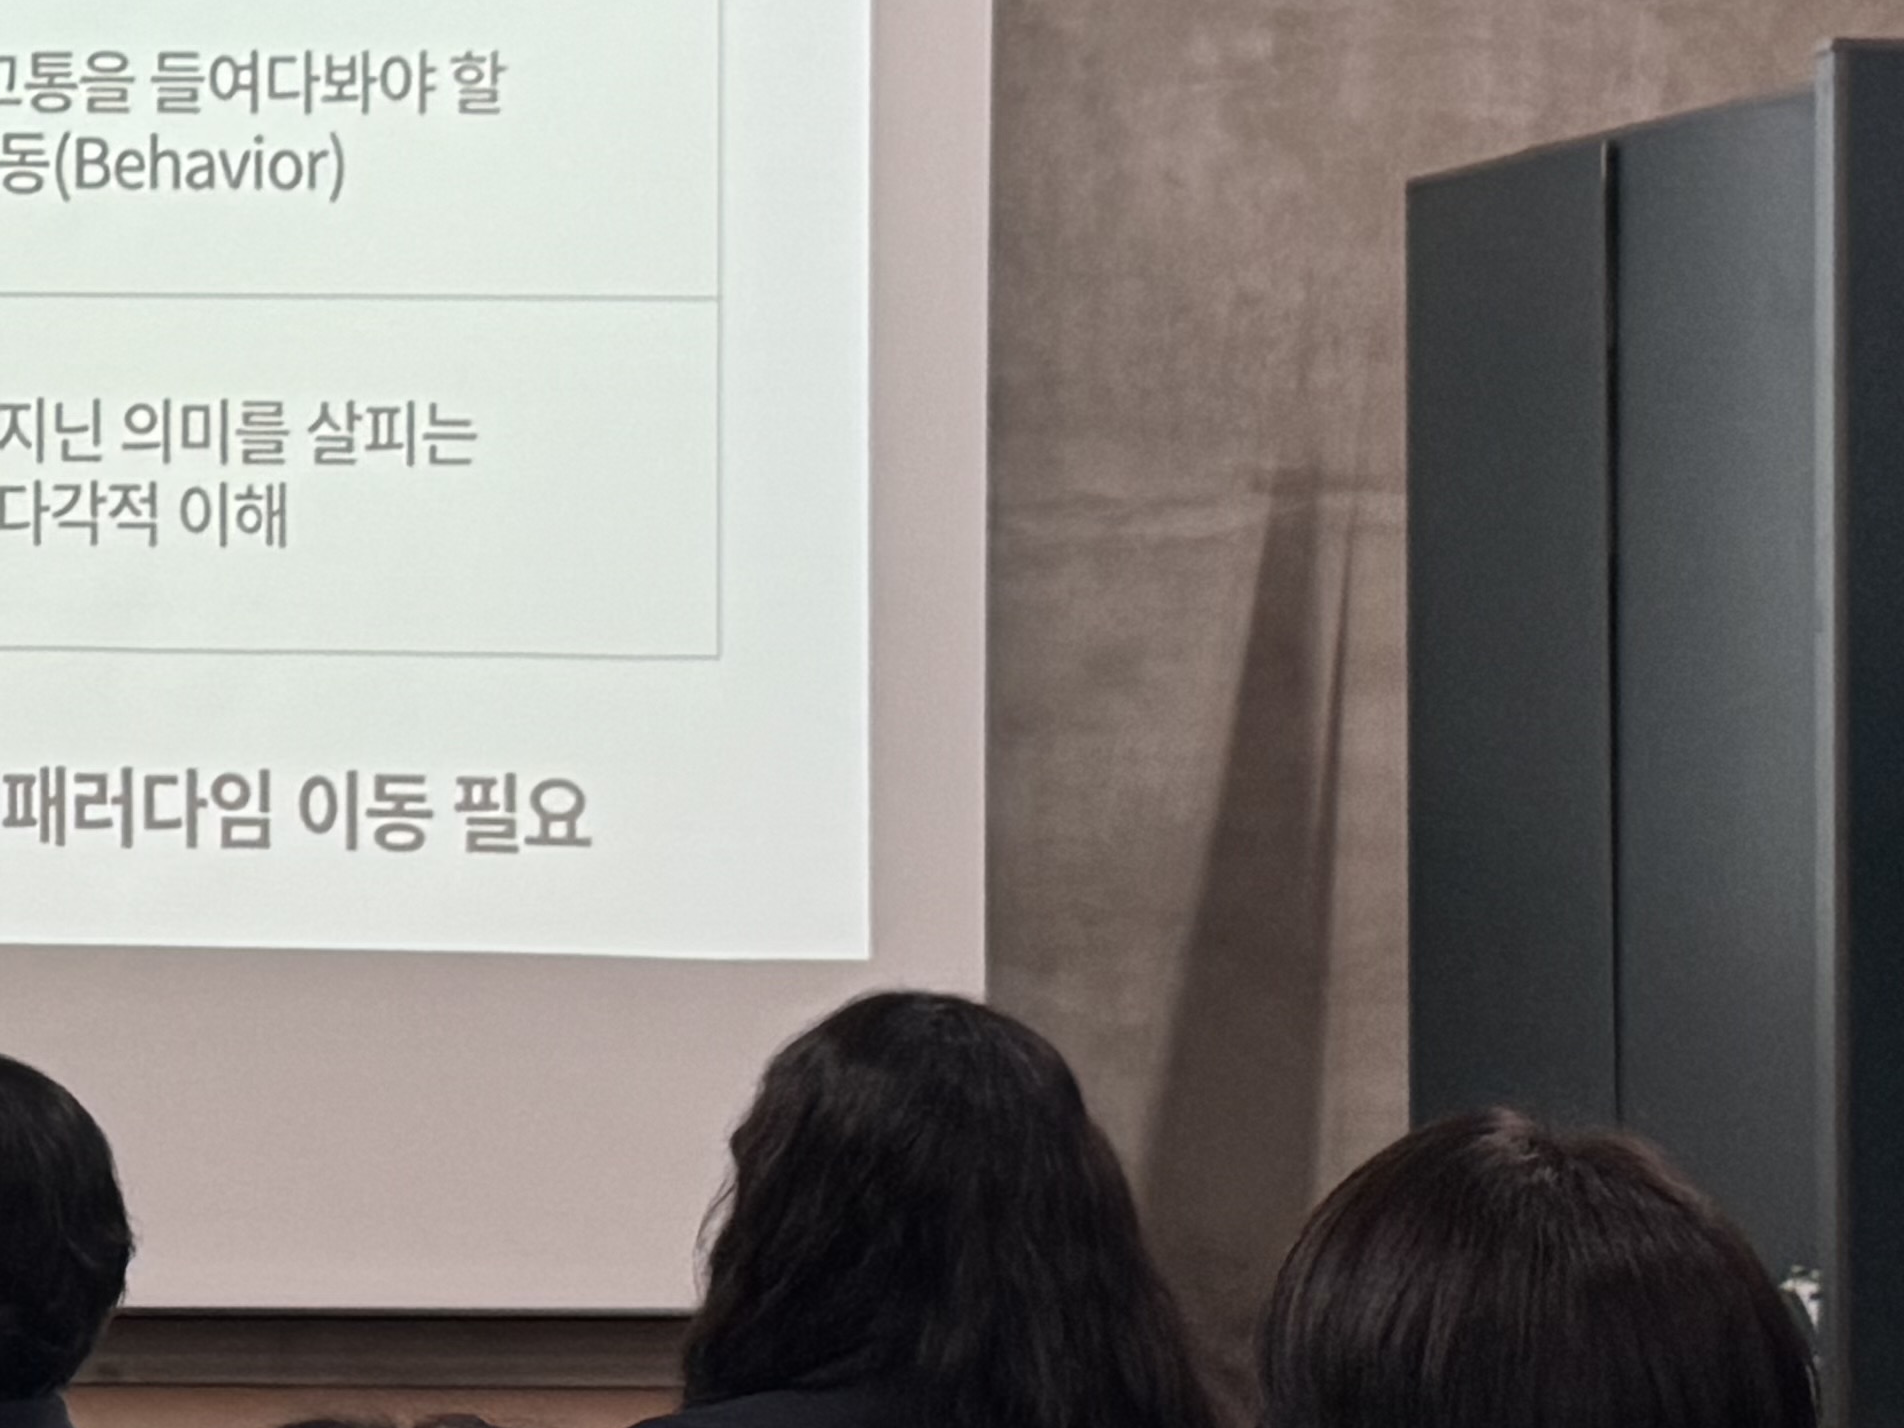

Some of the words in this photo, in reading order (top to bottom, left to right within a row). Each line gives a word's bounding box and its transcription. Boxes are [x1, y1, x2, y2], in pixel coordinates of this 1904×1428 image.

[150, 49, 437, 116] 들여다봐야
[450, 50, 507, 115] 할
[122, 398, 290, 466] 의미를
[307, 399, 478, 467] 살피는
[180, 481, 288, 548] 이해
[2, 765, 272, 850] 패러다임
[299, 769, 435, 853] 이동
[454, 772, 593, 855] 필요
